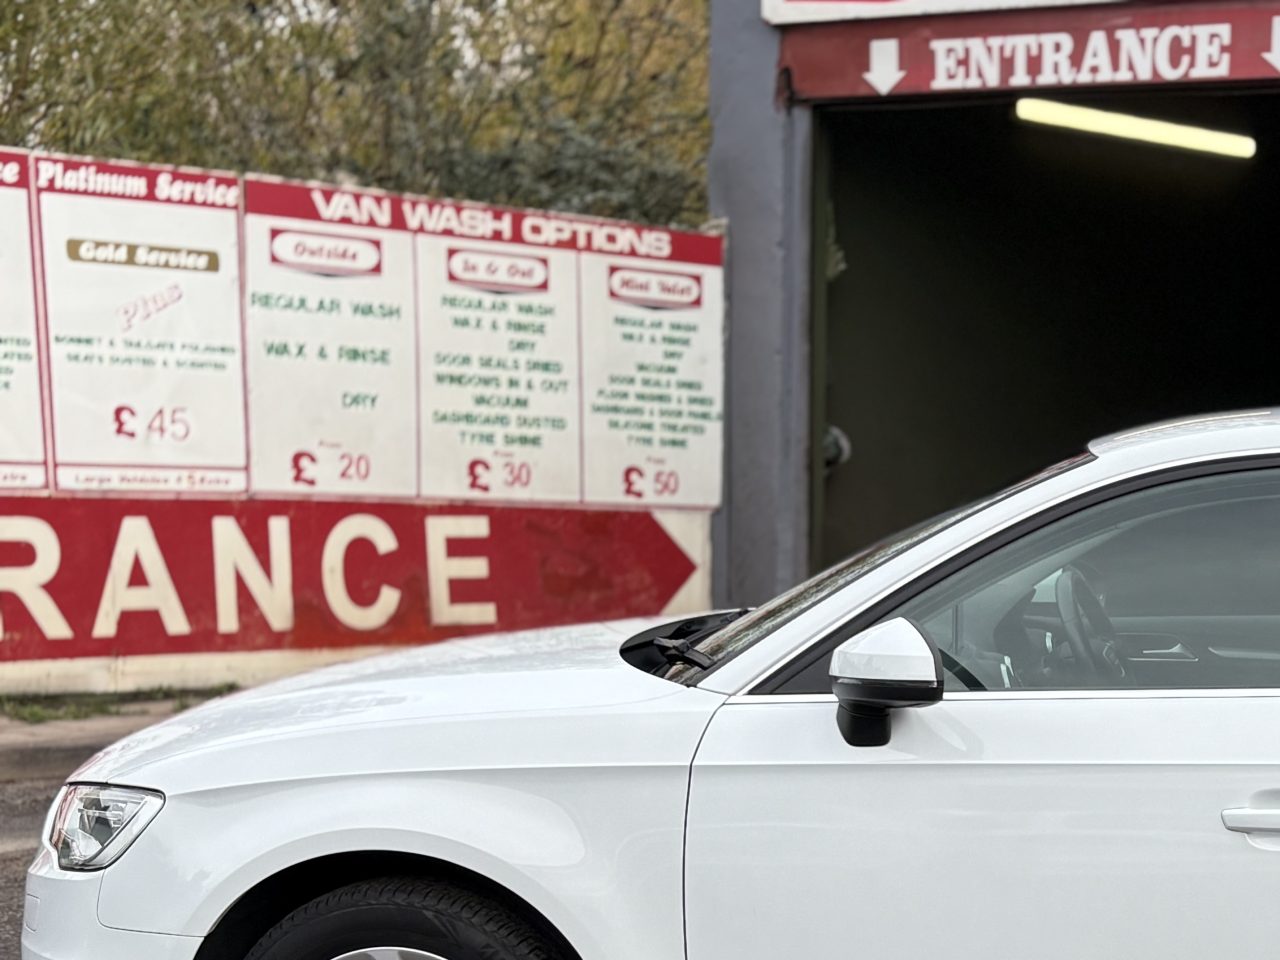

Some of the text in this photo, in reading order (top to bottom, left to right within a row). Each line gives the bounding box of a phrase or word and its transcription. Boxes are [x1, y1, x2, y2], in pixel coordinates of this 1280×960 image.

[929, 23, 1231, 92] ENTRANCE
[37, 160, 148, 199] Platinum
[154, 172, 240, 208] Service
[310, 189, 672, 258] VAN WASH OPTIONS
[79, 240, 209, 270] Gold Service
[293, 243, 358, 261] Outside
[251, 292, 403, 320] REGULAR WASH
[441, 296, 556, 316] REGULAR WASH
[451, 317, 482, 329] WAX
[506, 320, 546, 334] RINSE
[264, 341, 306, 358] WAX
[338, 345, 391, 363] RINSE
[341, 393, 378, 410] DRY
[473, 395, 529, 408] VACUUM
[113, 403, 191, 442] £ 45
[291, 451, 371, 486] £ 20
[468, 458, 532, 492] £ 30
[623, 464, 679, 498] £ 50
[0, 513, 498, 641] RANCE
